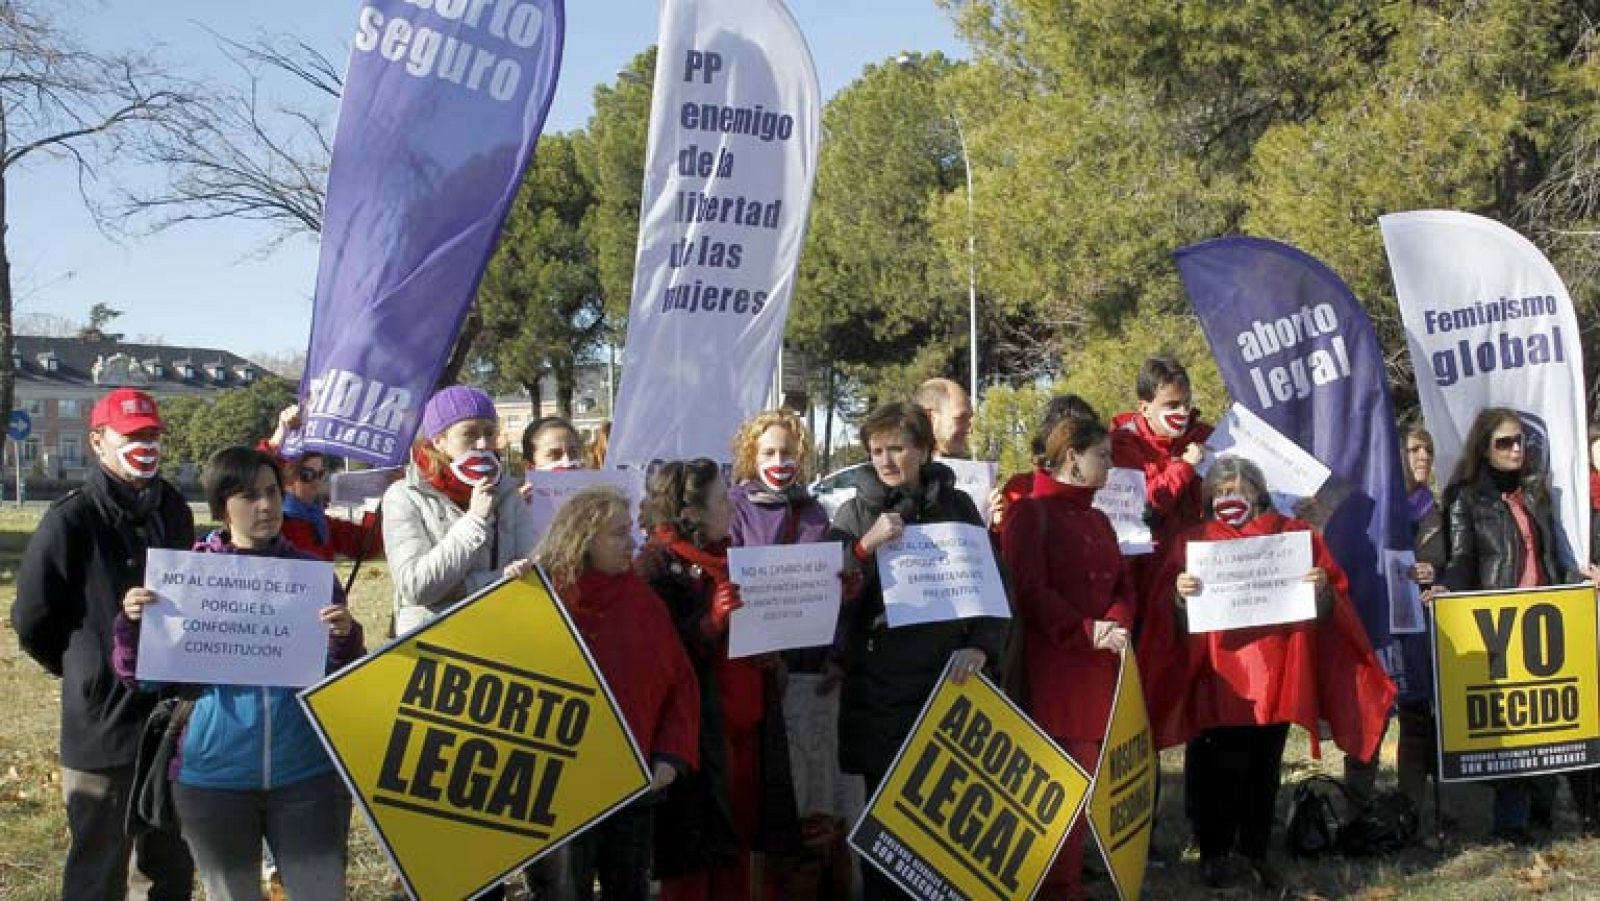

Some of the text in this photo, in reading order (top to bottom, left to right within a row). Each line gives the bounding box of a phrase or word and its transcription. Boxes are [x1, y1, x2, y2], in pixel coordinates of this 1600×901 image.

[355, 6, 521, 101] seguro
[683, 50, 722, 84] PP
[680, 102, 794, 142] enemigo
[678, 145, 714, 178] de
[674, 191, 782, 229] libertad
[698, 236, 743, 269] las
[1237, 302, 1338, 363] aborto
[1424, 294, 1557, 334] Feminismo
[1250, 335, 1350, 409] legal
[1433, 326, 1564, 387] global
[162, 573, 184, 585] NO
[187, 575, 203, 586] AL
[207, 576, 261, 591] CAMBIO
[264, 581, 282, 593] DE
[183, 619, 290, 637] CONFORME A LA
[201, 599, 276, 616] PORQUE ES
[1472, 603, 1566, 680] YO
[400, 656, 591, 747] ABORTO
[1466, 685, 1580, 730] DECIDO
[376, 717, 566, 827] LEGAL
[937, 694, 1066, 825] ABORTO
[901, 740, 1036, 893] LEGAL
